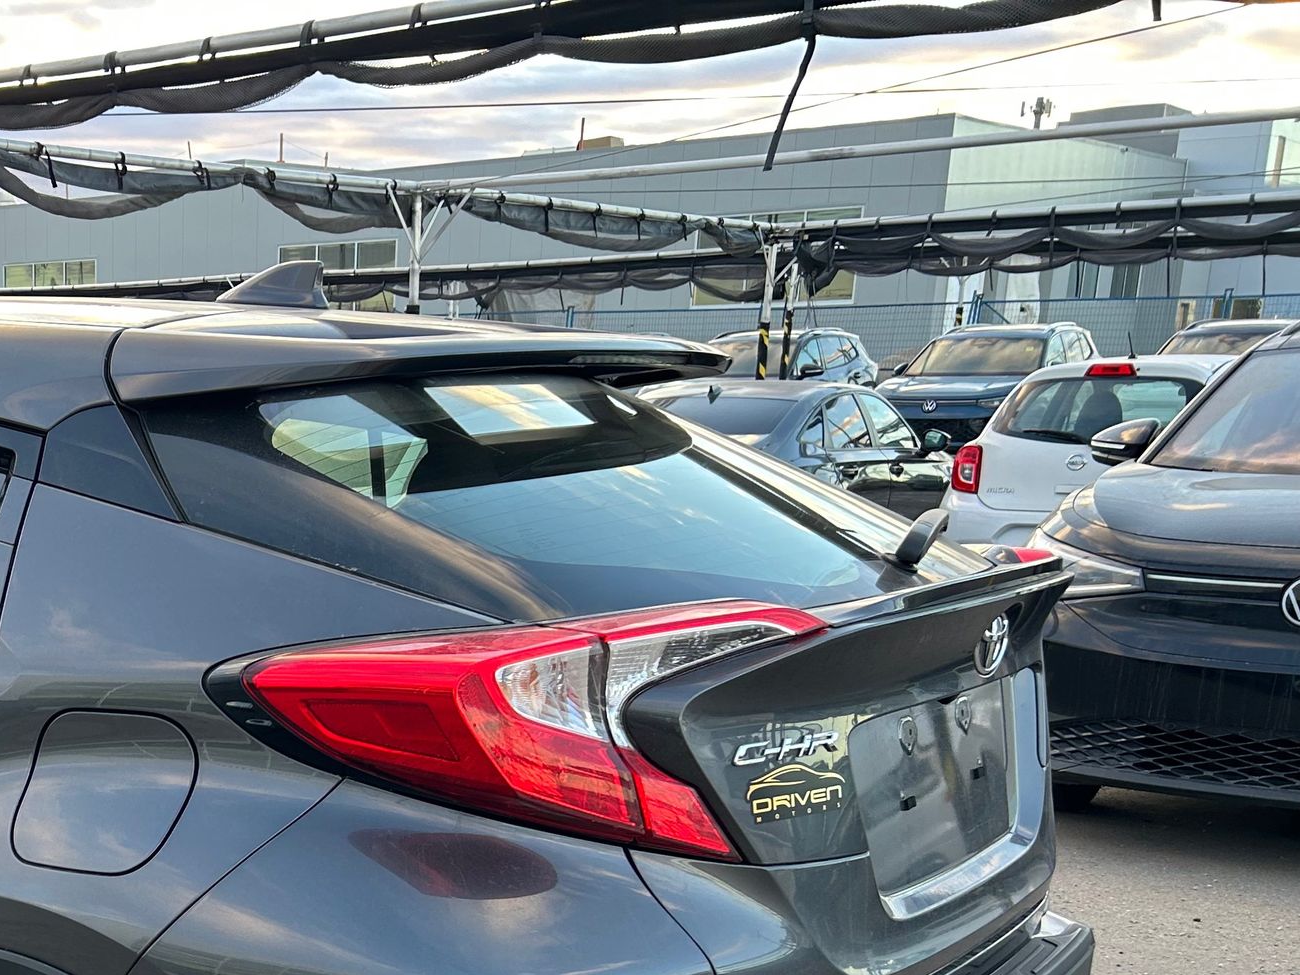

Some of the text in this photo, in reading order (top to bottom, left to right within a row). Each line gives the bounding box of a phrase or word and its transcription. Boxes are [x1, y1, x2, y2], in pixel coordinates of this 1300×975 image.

[733, 731, 839, 766] C-HR
[752, 785, 842, 814] DRIVEN
[756, 802, 841, 823] MOTORS
